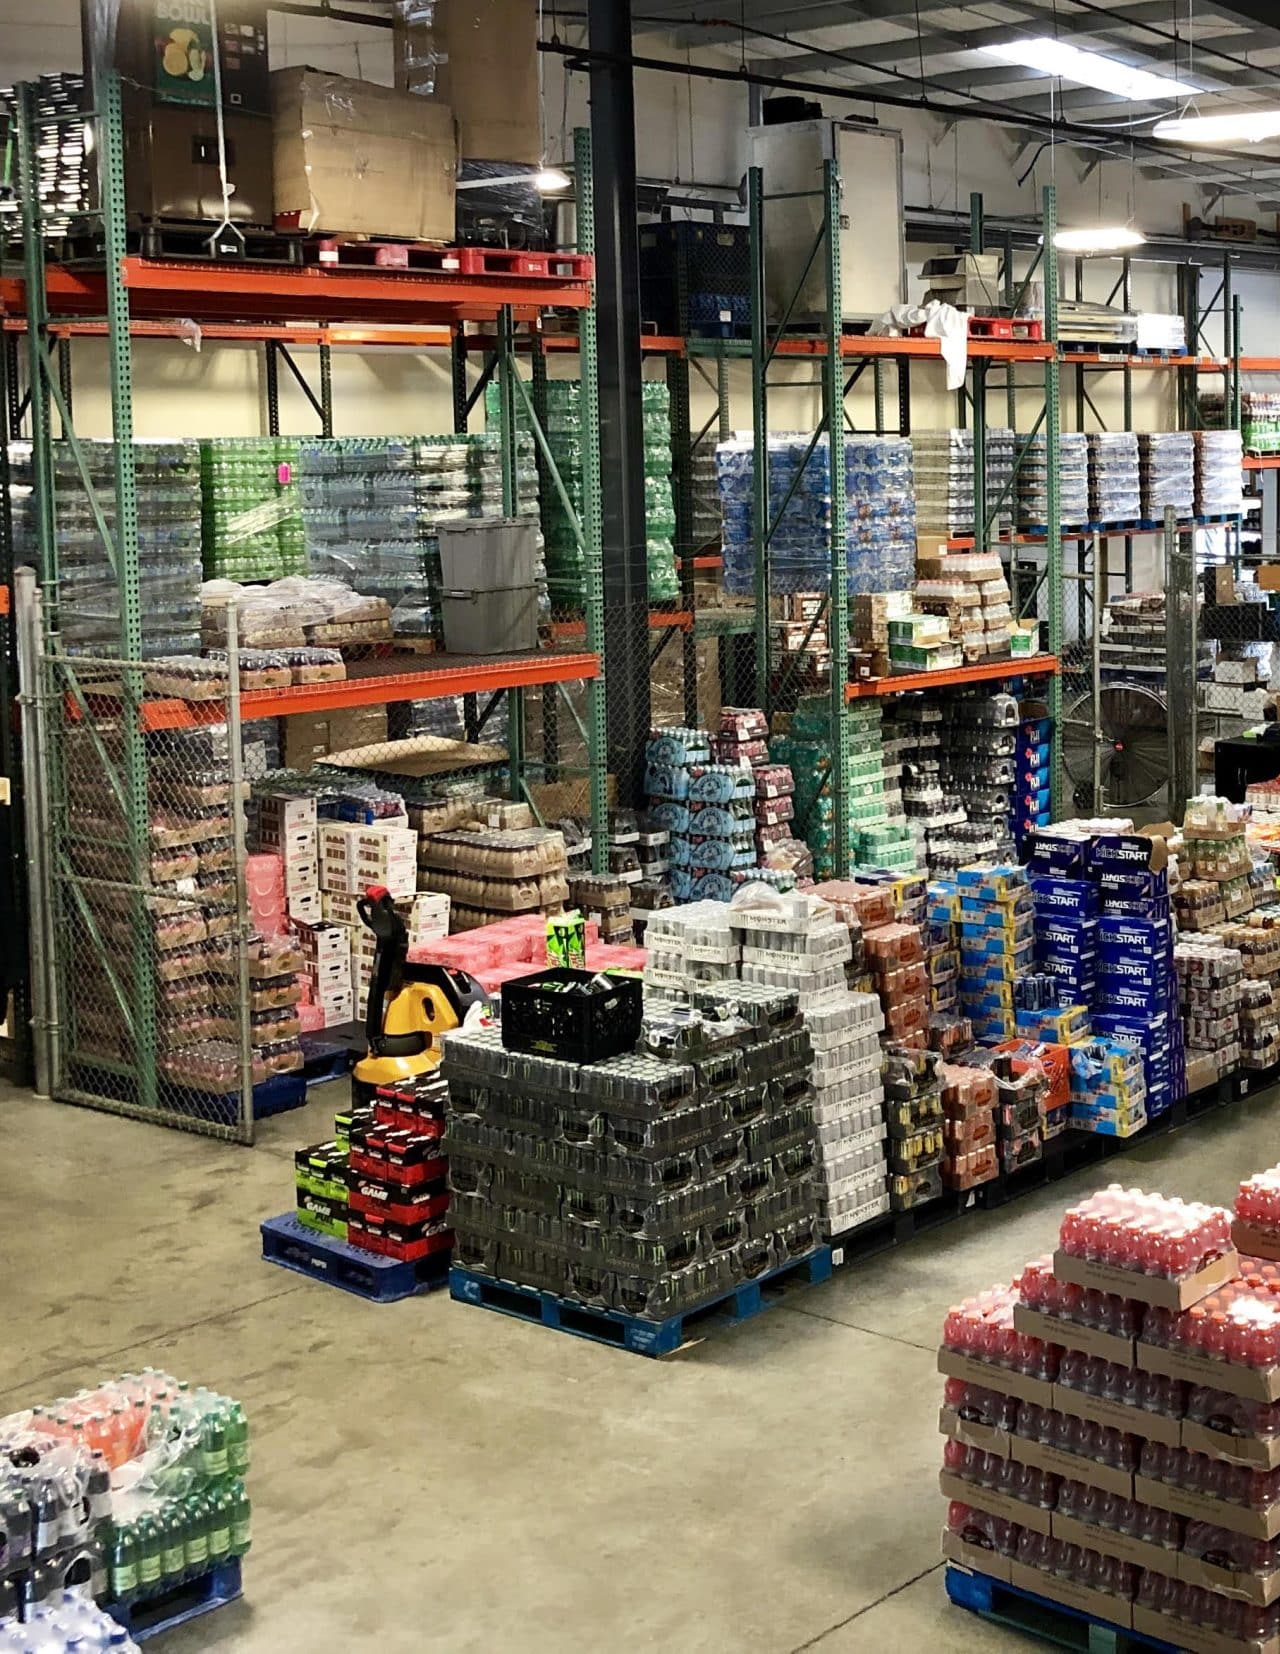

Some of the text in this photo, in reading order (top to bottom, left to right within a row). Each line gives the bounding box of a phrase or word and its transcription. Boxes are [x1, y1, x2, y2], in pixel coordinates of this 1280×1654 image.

[1096, 845, 1149, 861] KICKSTART
[750, 915, 787, 926] MONSTER
[766, 951, 800, 962] MONSTER
[361, 1188, 388, 1200] GAME
[306, 1202, 331, 1215] GAME
